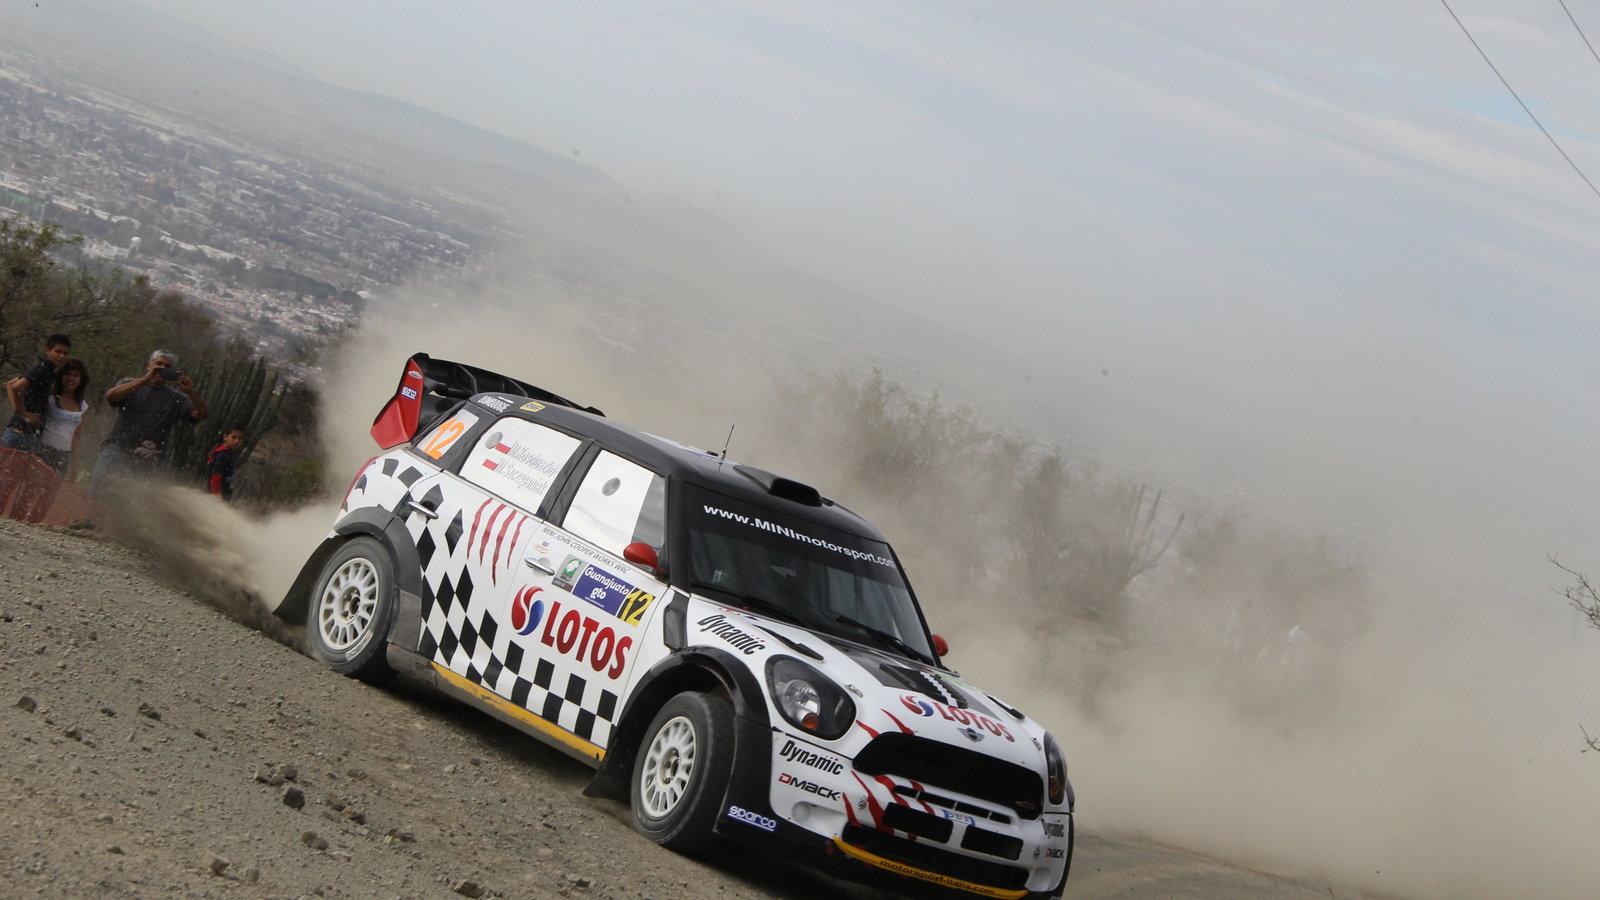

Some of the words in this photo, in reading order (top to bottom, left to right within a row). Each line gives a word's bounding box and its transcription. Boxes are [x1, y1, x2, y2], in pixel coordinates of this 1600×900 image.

[422, 418, 465, 460] 12
[542, 527, 555, 539] MINI
[554, 533, 571, 546] JOHN
[569, 539, 594, 557] COOPER
[593, 550, 615, 568] WORKS
[614, 561, 631, 574] WRC
[703, 505, 896, 569] www.MINImotorsport.com
[584, 567, 630, 595] Guanajuato
[590, 587, 607, 600] gto
[617, 588, 656, 627] 12
[541, 601, 633, 680] LOTOS
[697, 614, 766, 655] Dynamic
[932, 701, 1016, 742] LOTOS
[779, 740, 844, 775] Dynamic
[729, 805, 777, 831] sparco
[879, 860, 996, 896] motorsport-italia.com
